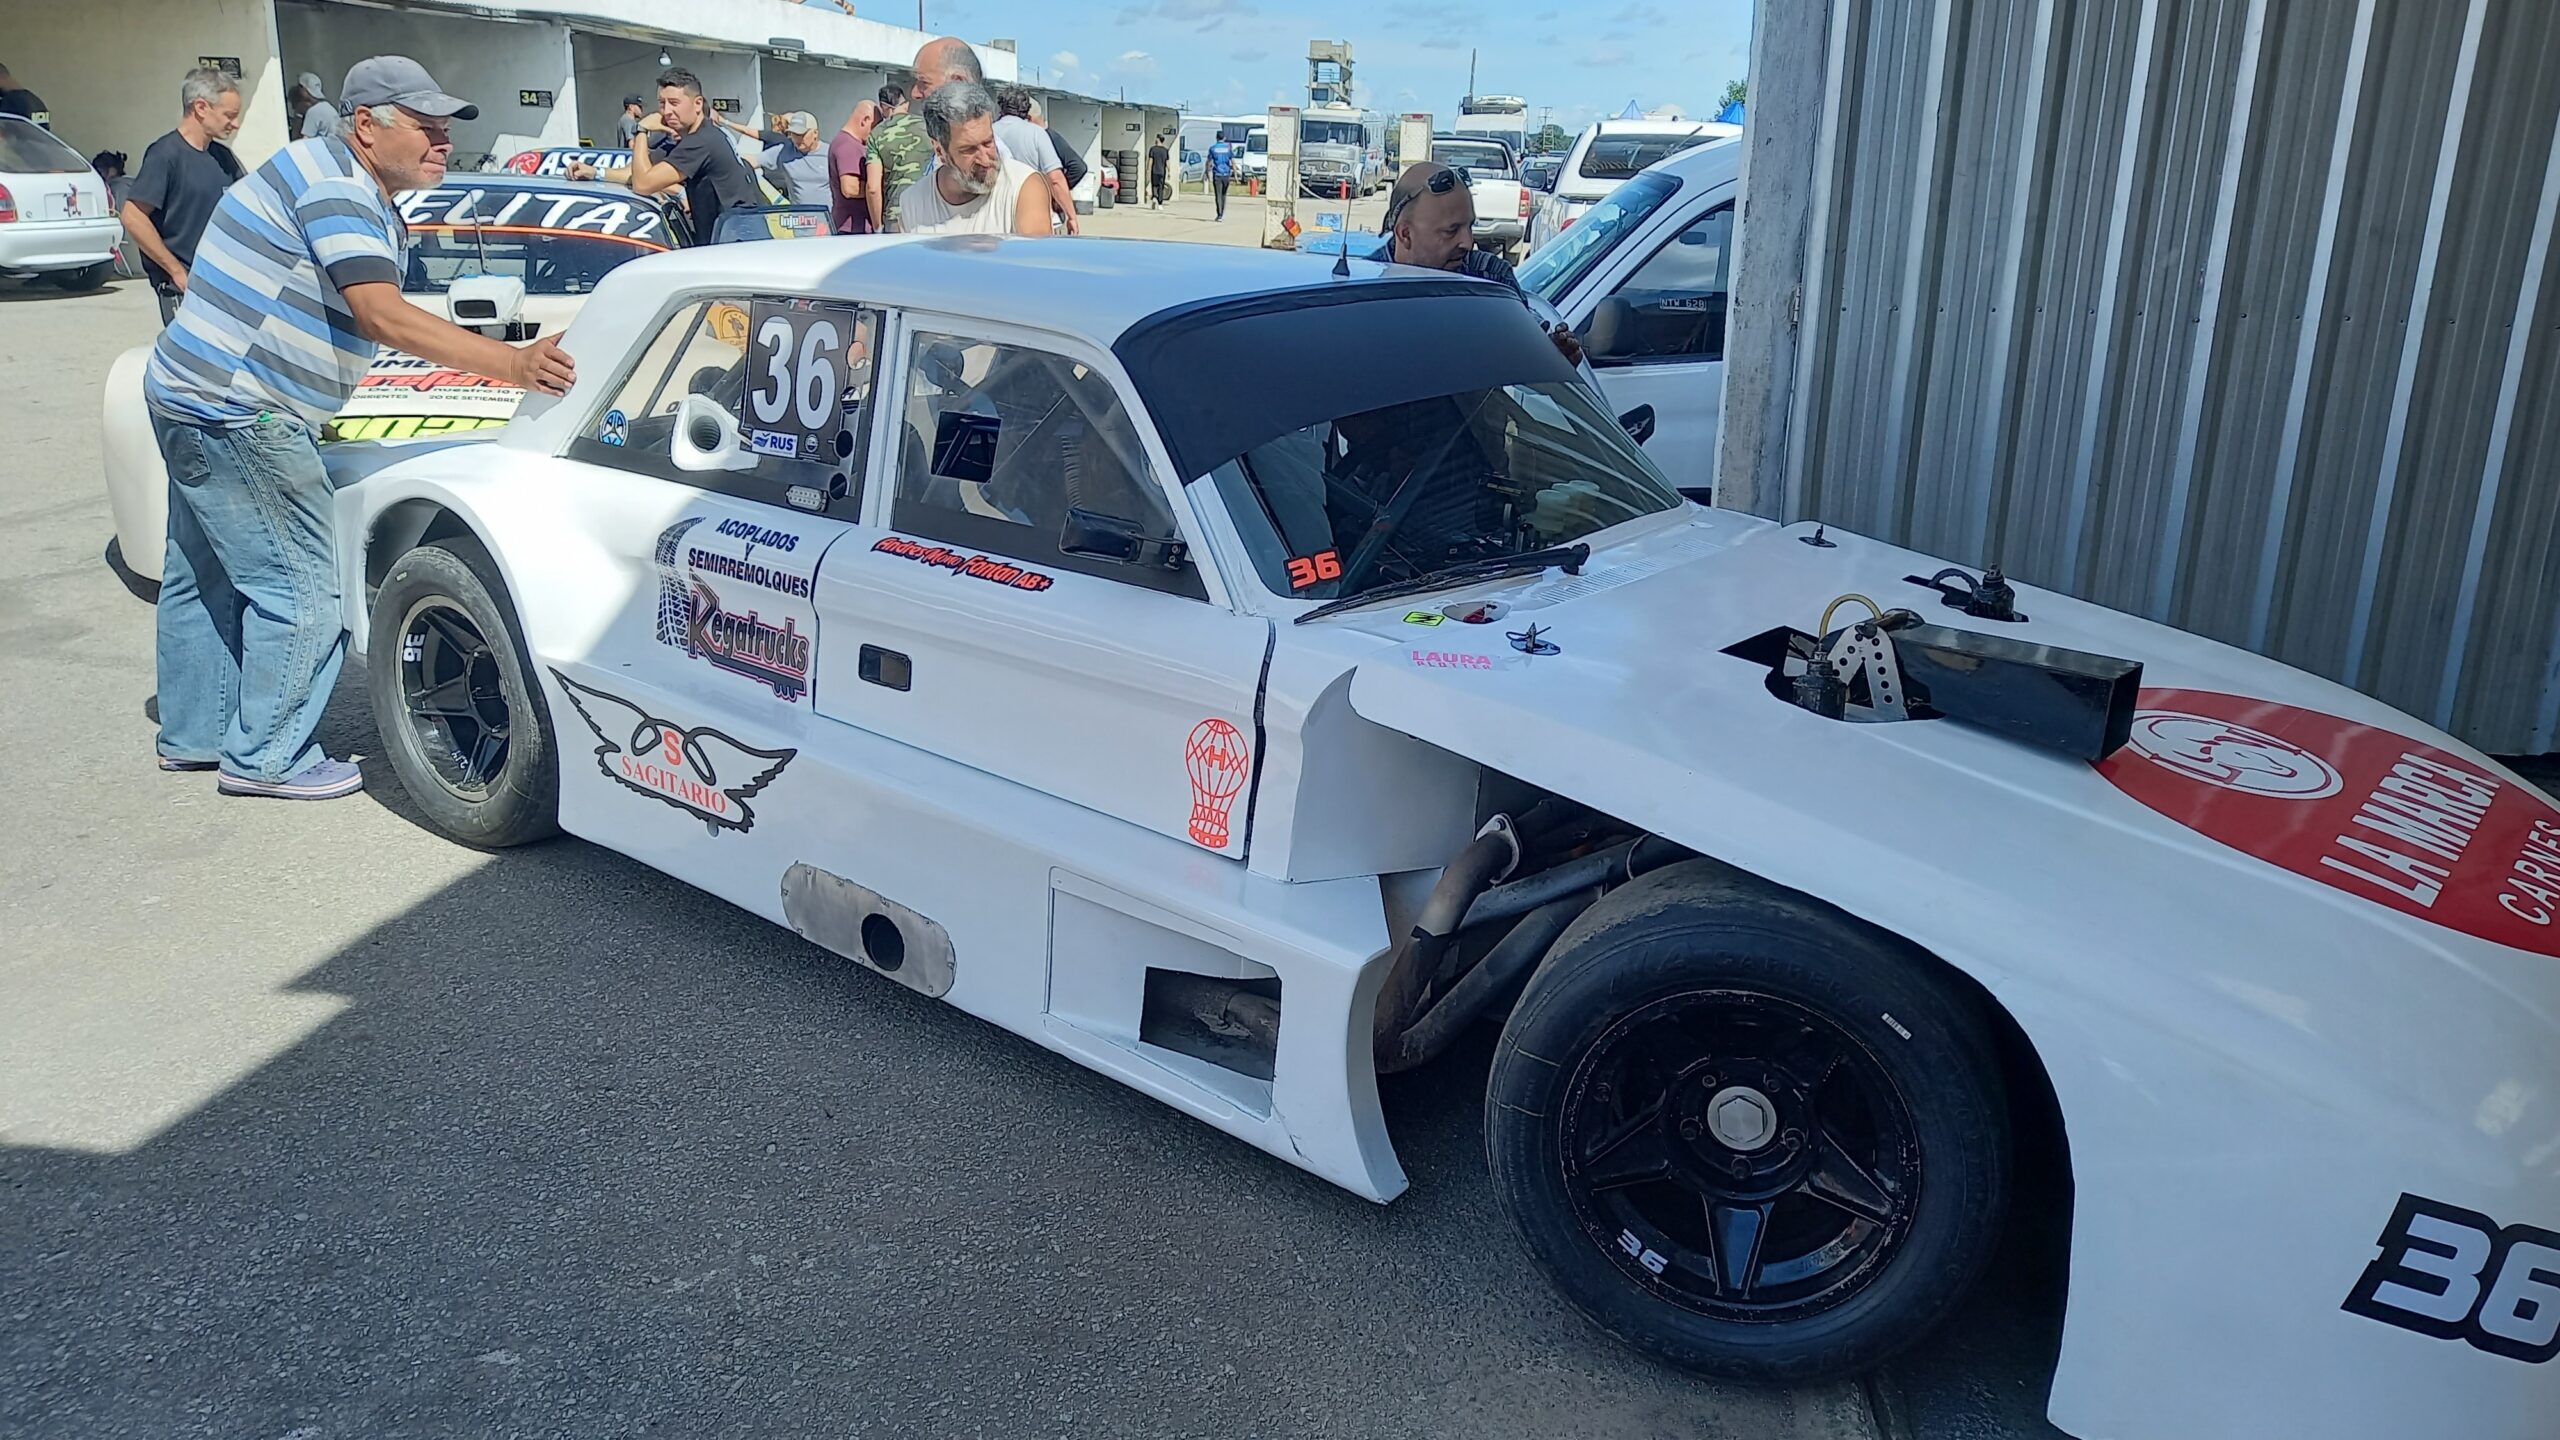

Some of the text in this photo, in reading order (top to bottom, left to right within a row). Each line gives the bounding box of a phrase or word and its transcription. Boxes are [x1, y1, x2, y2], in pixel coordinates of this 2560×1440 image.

[521, 91, 538, 104] 34
[713, 100, 727, 110] 33
[751, 315, 840, 431] 36
[770, 435, 794, 452] RUS
[715, 518, 800, 552] ACOPLADOS
[744, 542, 756, 561] Y
[687, 547, 809, 599] SEMIRREMOLQUES
[953, 554, 1023, 586] Fontan
[1287, 551, 1341, 589] 36
[402, 633, 426, 662] 36
[1412, 650, 1493, 665] LAURA
[663, 730, 681, 766] S
[621, 755, 727, 814] SAGITARIO
[2319, 752, 2501, 909] LA MARCA
[1616, 1228, 1669, 1274] 36
[2358, 1202, 2560, 1354] 36
